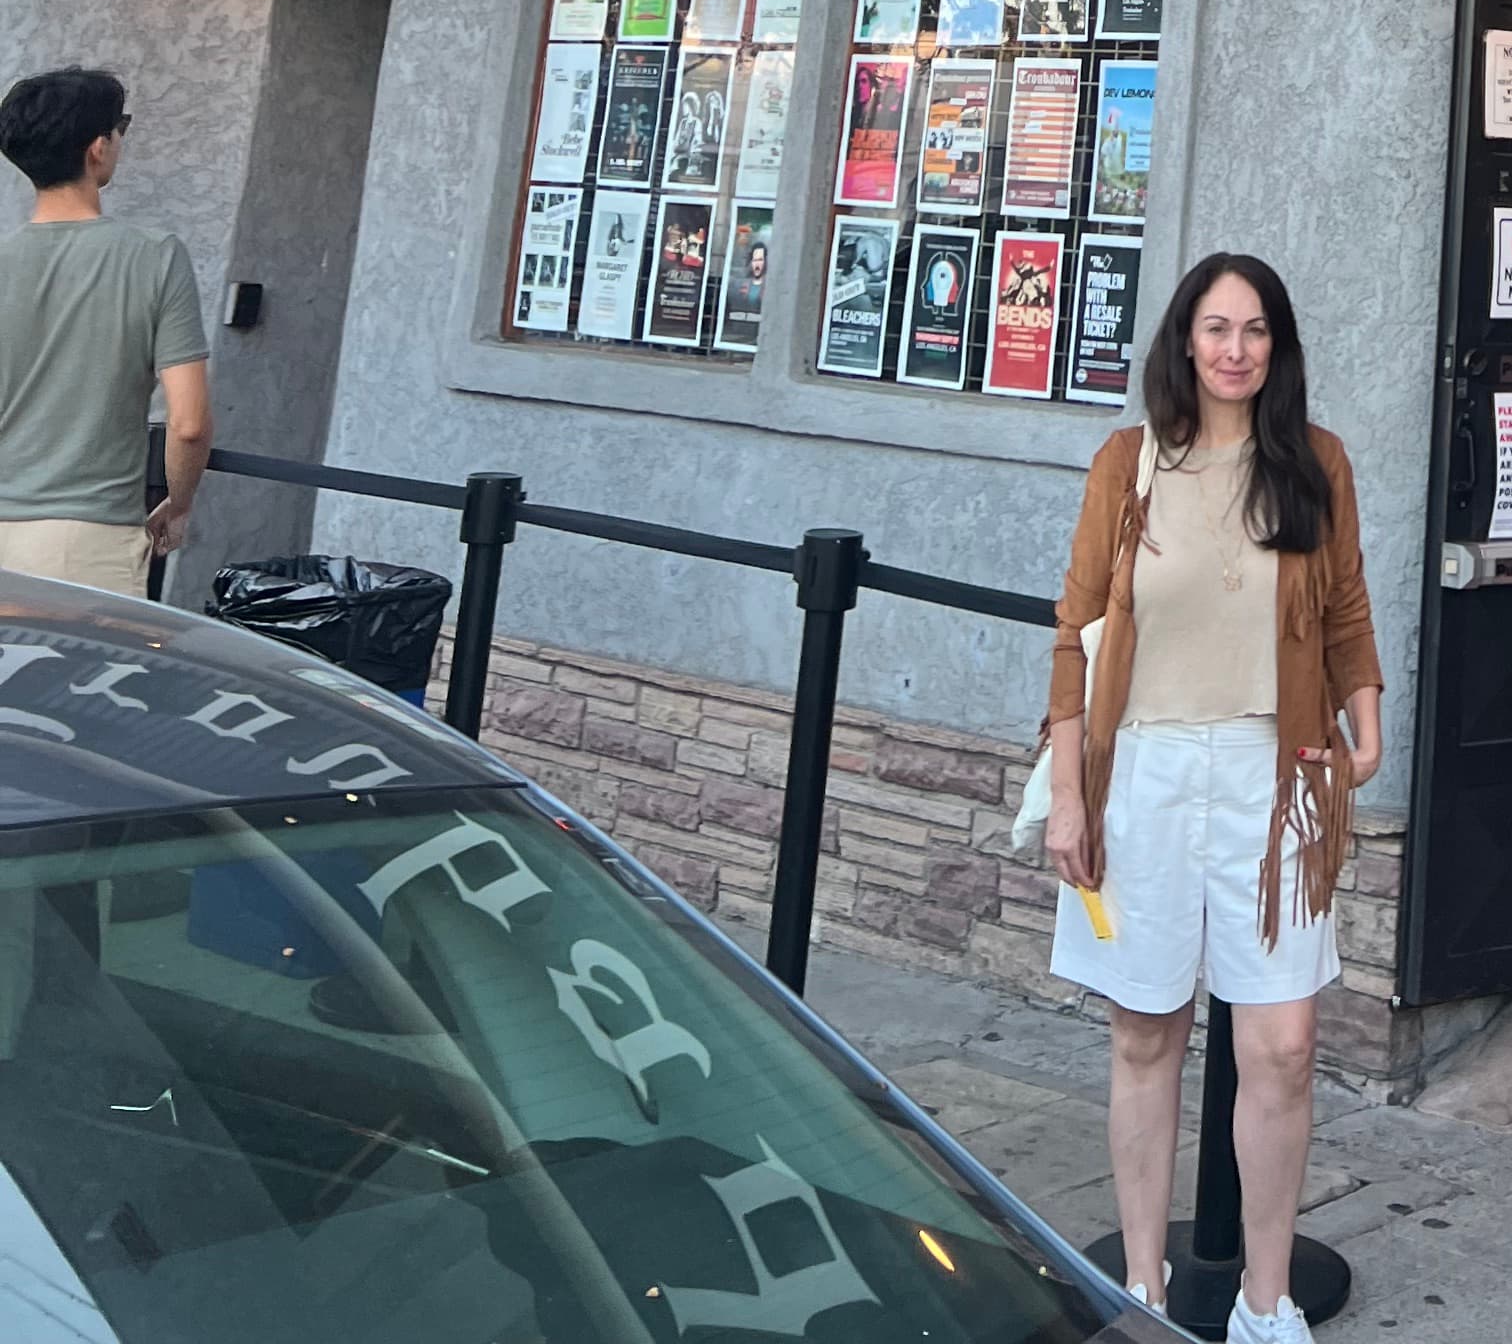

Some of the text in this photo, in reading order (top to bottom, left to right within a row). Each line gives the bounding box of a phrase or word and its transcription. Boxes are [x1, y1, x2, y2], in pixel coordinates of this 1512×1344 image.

[1018, 70, 1077, 86] Troubadour
[1086, 271, 1126, 290] PROBLEM
[1085, 288, 1108, 305] WITH
[831, 309, 881, 327] BLEACHERS
[997, 304, 1052, 330] BENDS
[1092, 305, 1123, 322] RESALE
[1083, 320, 1117, 339] TICKET?
